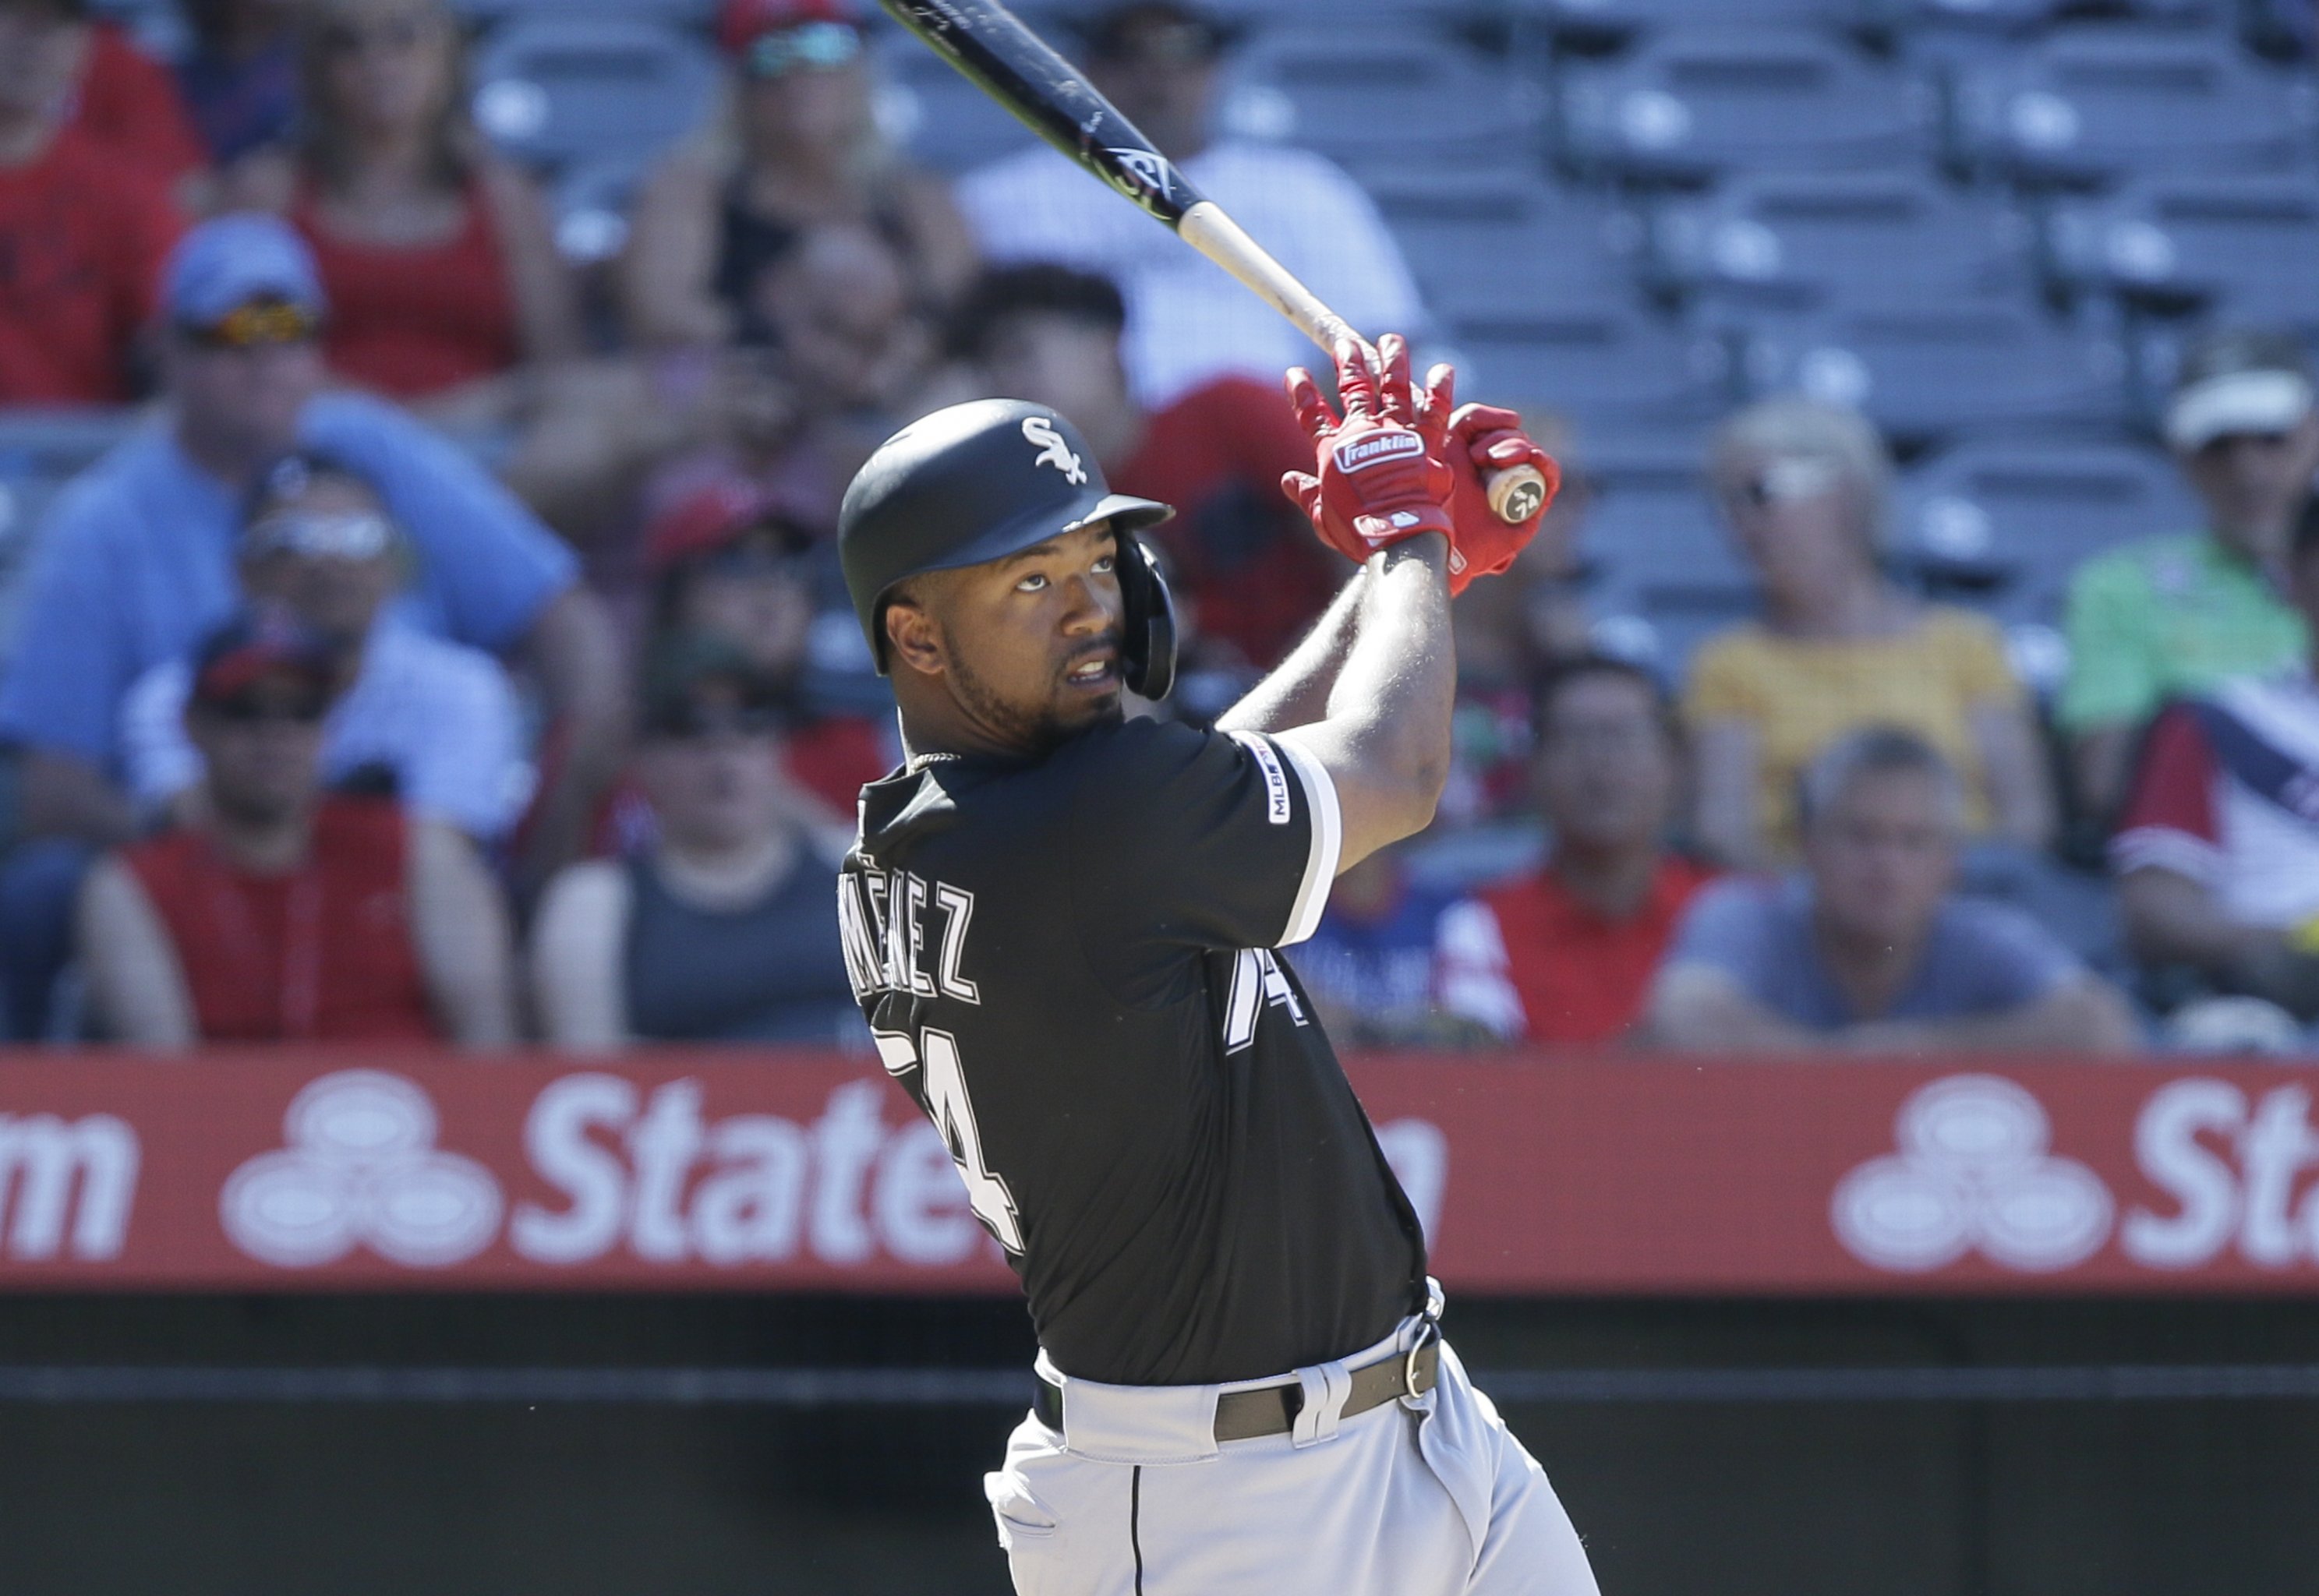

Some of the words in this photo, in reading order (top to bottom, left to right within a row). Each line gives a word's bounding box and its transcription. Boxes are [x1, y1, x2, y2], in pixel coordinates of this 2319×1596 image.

[1344, 435, 1418, 468] Franklin
[1271, 775, 1285, 816] MLB
[511, 1072, 981, 1266] State
